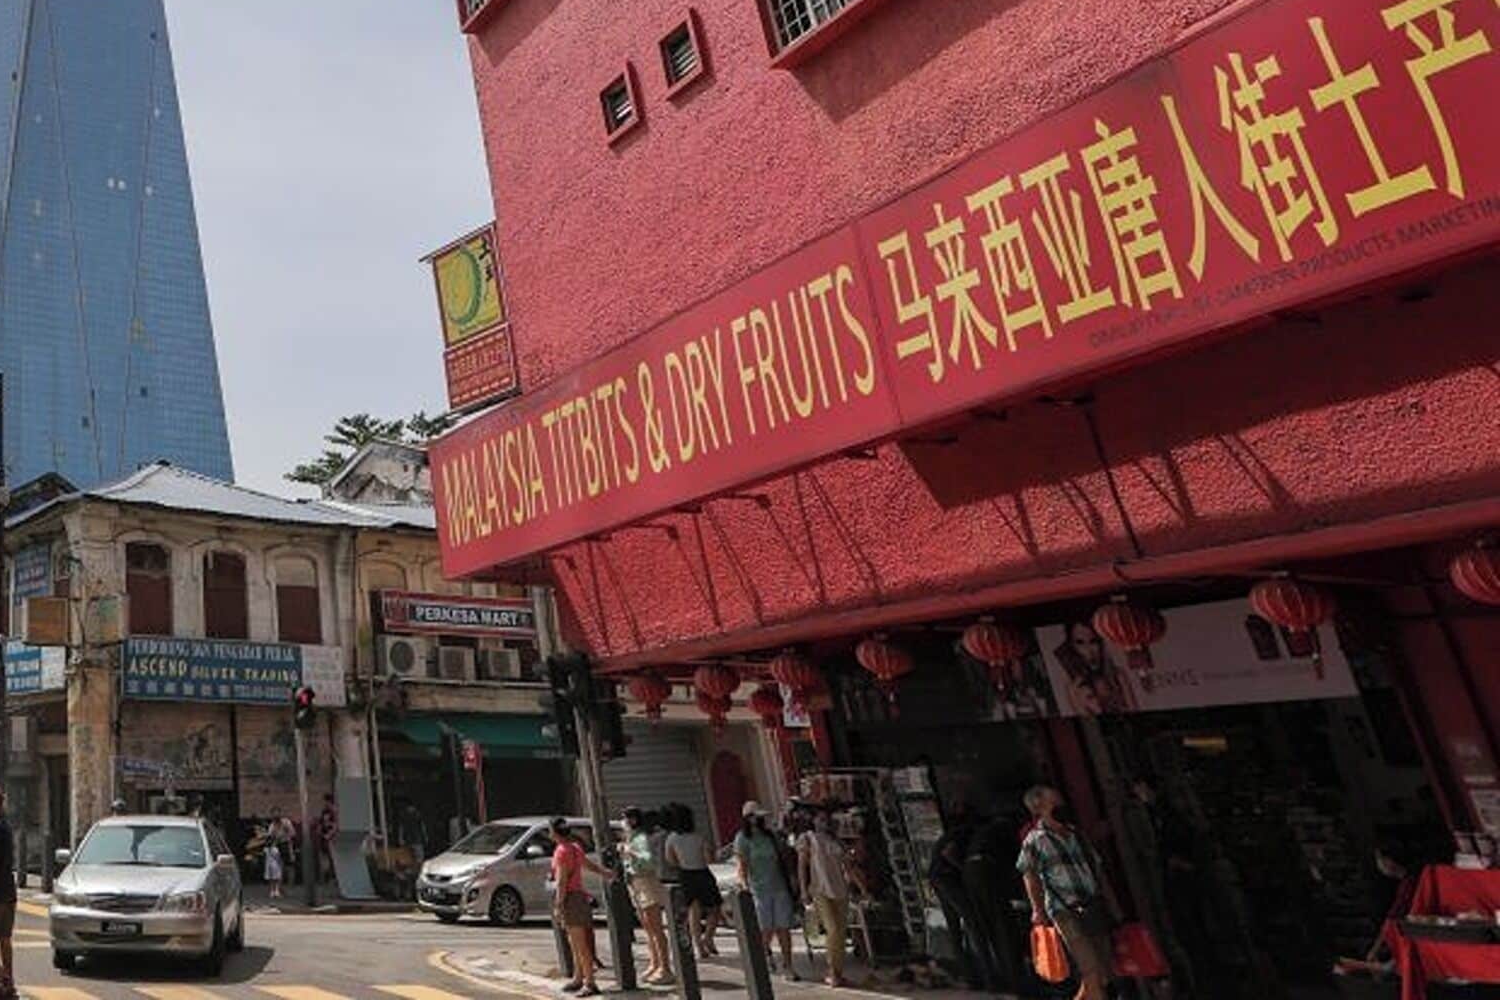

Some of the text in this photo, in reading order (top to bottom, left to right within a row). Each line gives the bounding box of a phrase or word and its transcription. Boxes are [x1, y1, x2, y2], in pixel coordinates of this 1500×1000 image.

[442, 264, 875, 548] MALAYSIA TITBITS & DRY FRUITS
[481, 611, 517, 626] MART
[129, 656, 188, 678] ASCEND
[244, 668, 299, 682] TRADING
